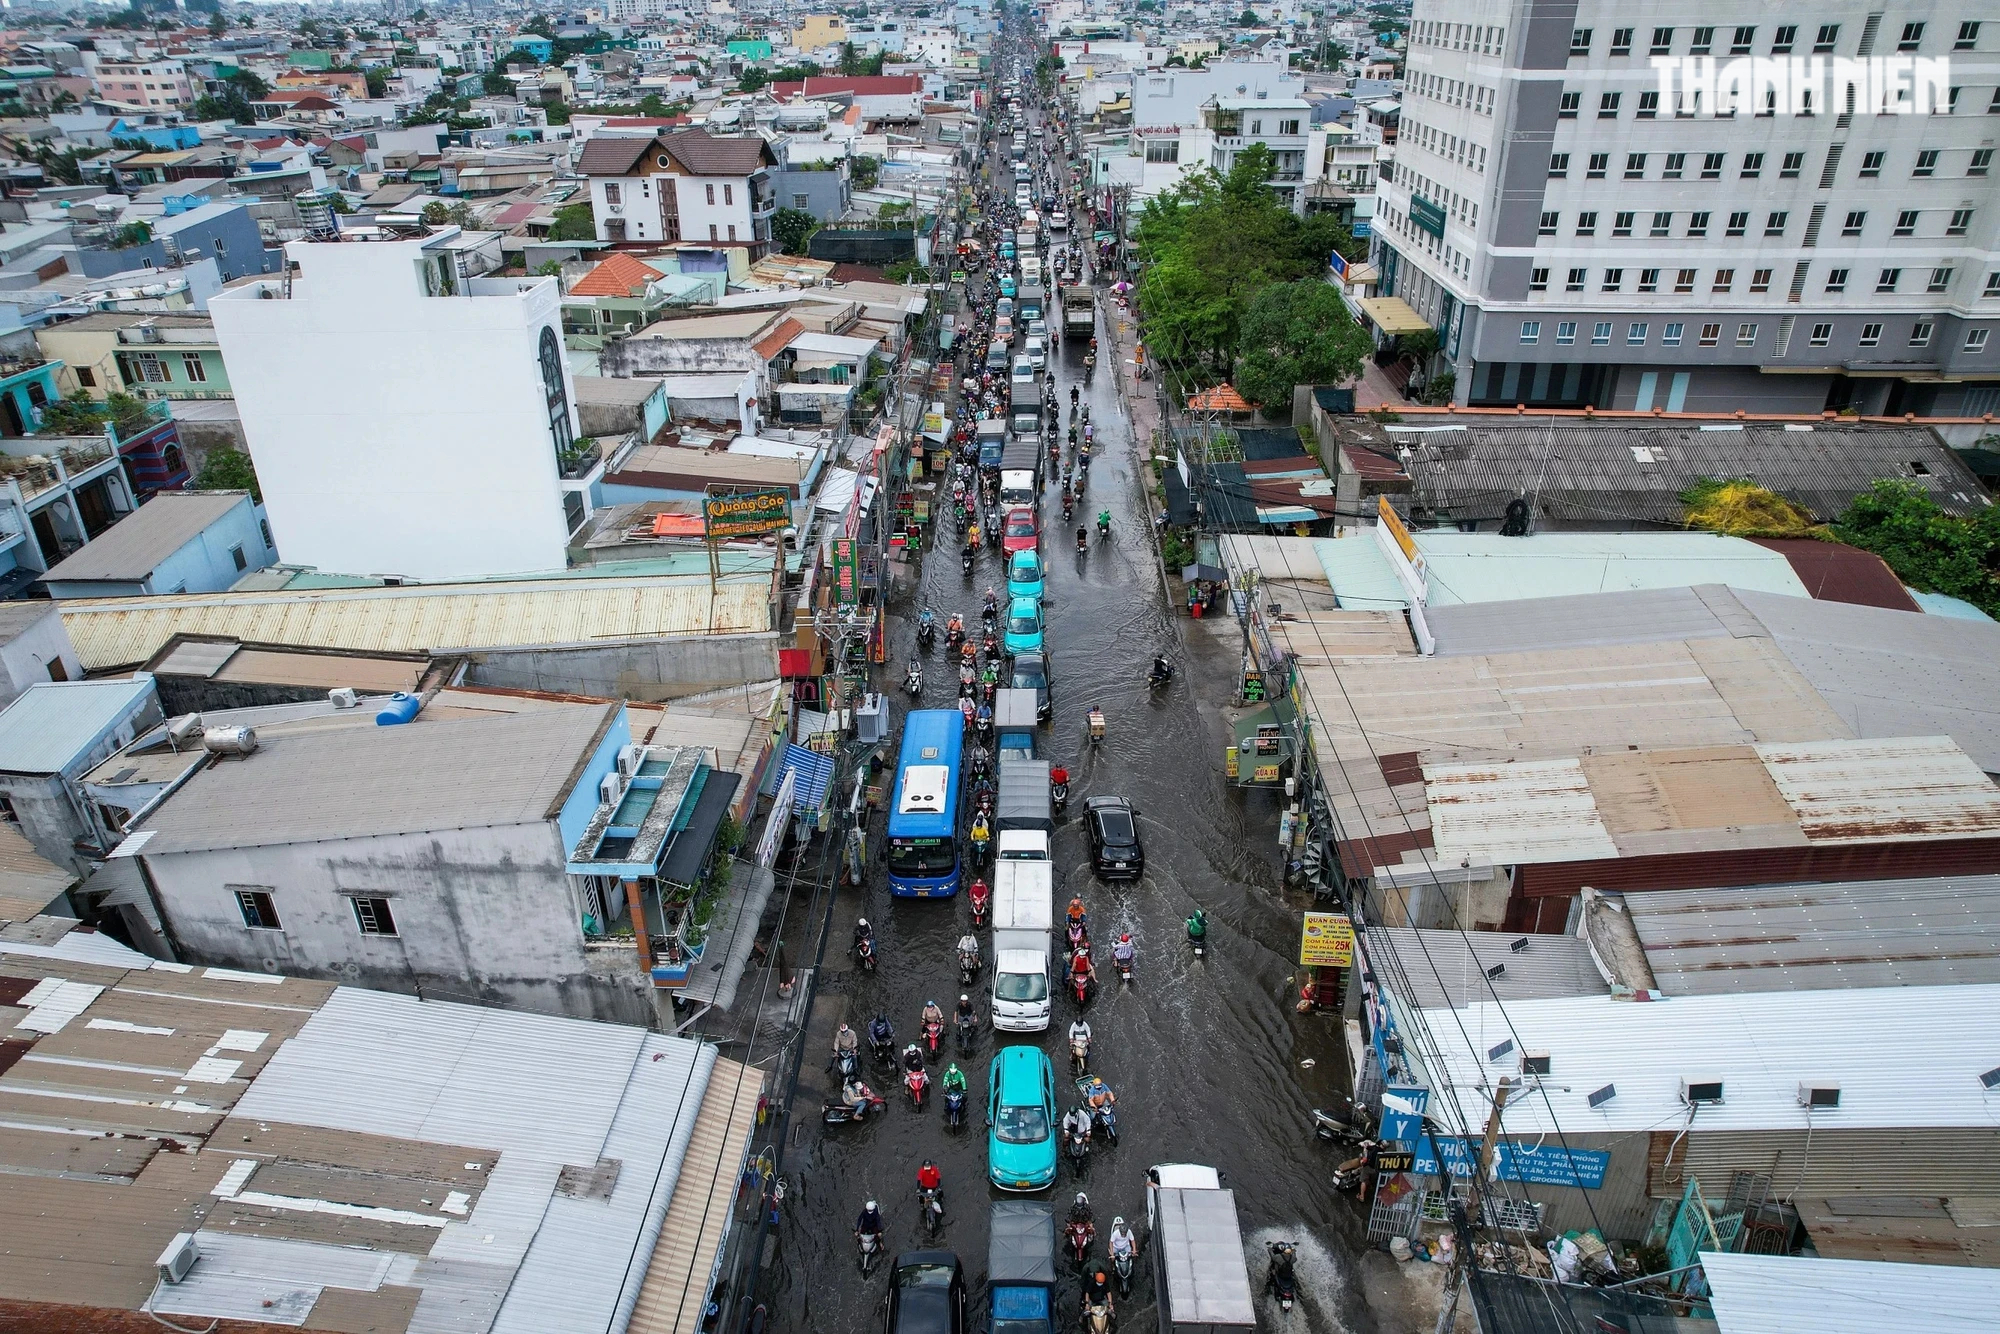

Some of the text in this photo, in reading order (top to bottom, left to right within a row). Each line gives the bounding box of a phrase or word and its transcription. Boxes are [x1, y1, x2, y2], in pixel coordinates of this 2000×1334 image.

[1335, 941, 1350, 950] 25K
[1396, 1120, 1409, 1139] Y
[1379, 1155, 1411, 1169] THÚ Y
[1548, 1151, 1569, 1160] TIÊM
[1570, 1154, 1600, 1163] PHÒNG
[1547, 1167, 1563, 1176] XÉT
[1530, 1175, 1573, 1185] GROOMING
